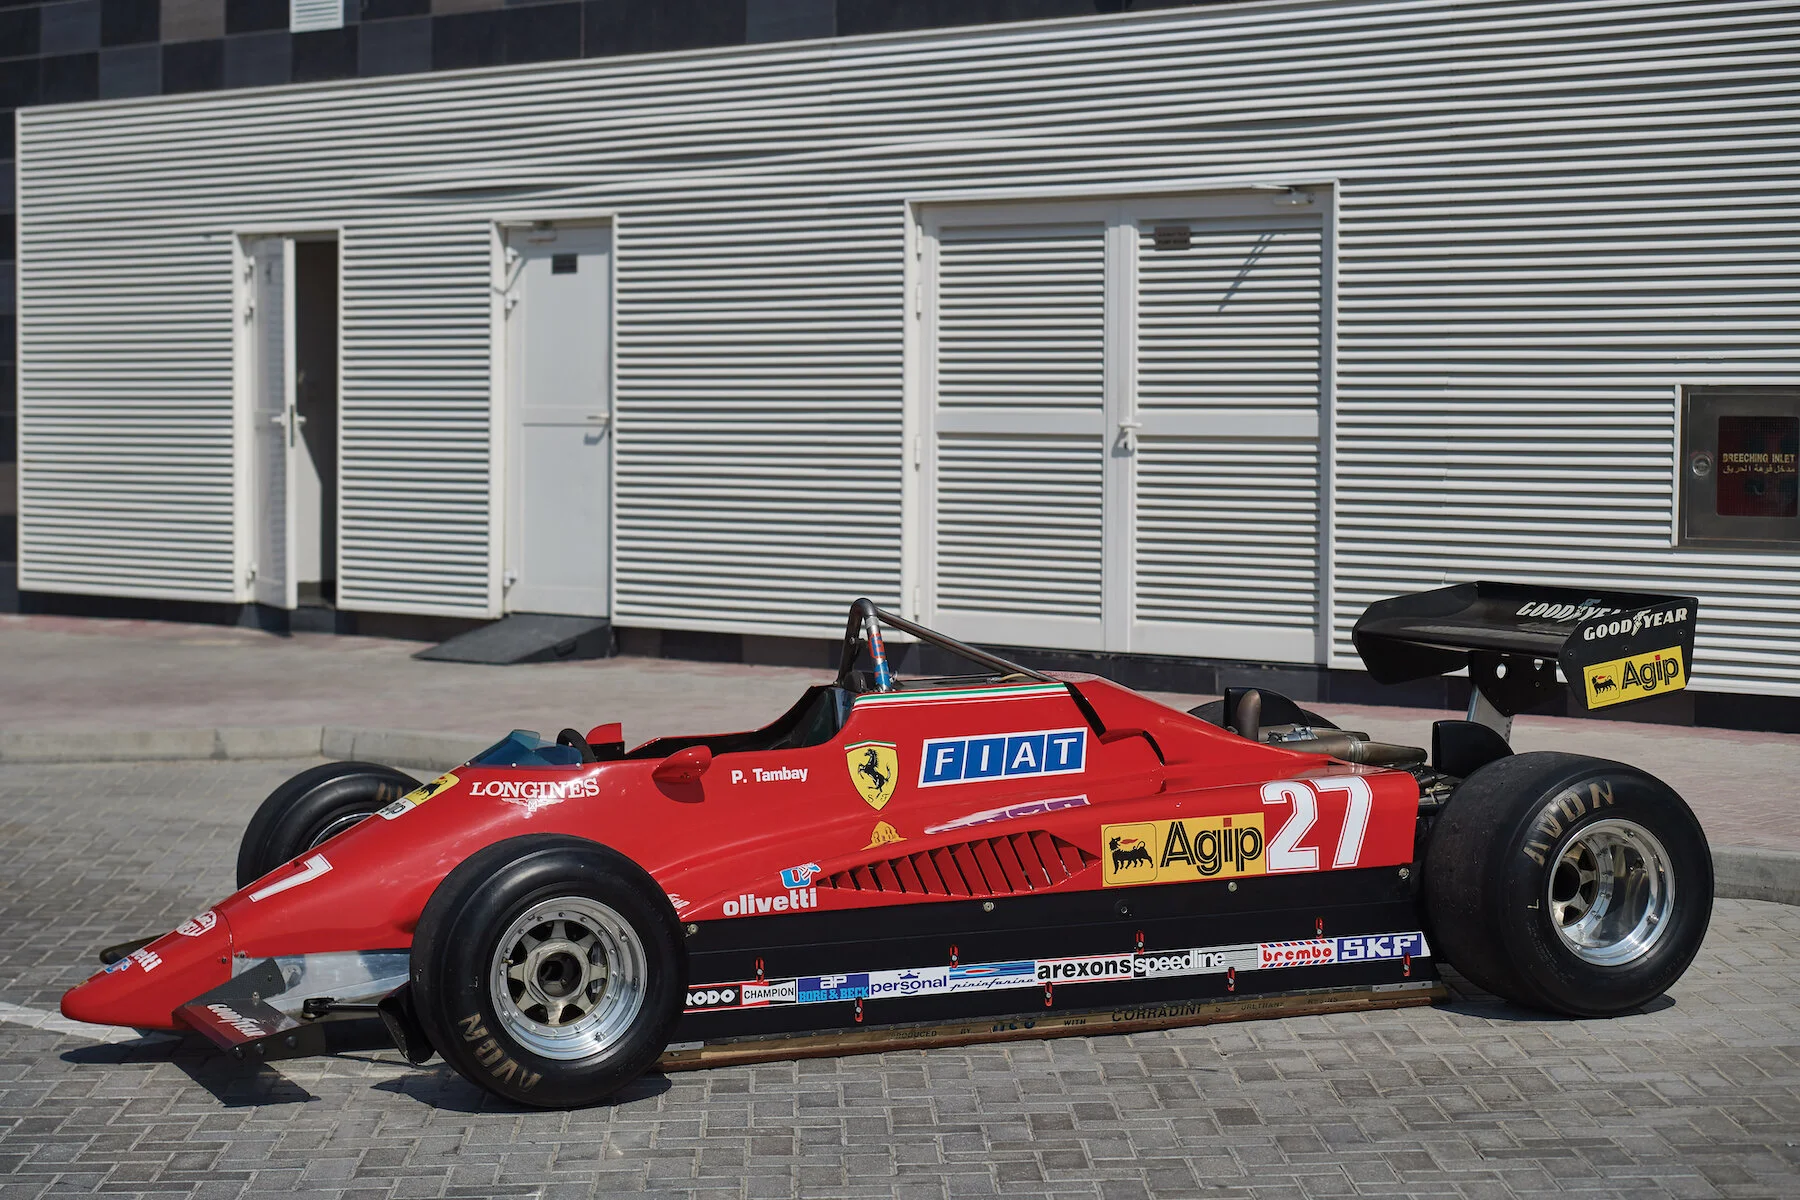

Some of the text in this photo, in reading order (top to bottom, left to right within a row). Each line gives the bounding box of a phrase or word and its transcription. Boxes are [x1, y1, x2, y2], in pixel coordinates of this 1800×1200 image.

[1723, 453, 1796, 463] BREECHING INLET
[1583, 608, 1688, 641] GOODYEAR
[1622, 654, 1680, 691] Agip
[934, 738, 1078, 776] FIAT
[731, 766, 809, 784] P. Tambay
[469, 778, 600, 799] LONGINES
[1260, 775, 1373, 874] 27
[1523, 779, 1616, 867] AVON
[1160, 818, 1263, 877] Agip
[723, 887, 818, 916] olivetti
[1263, 946, 1332, 962] brembo
[1341, 934, 1418, 960] SKF
[1037, 958, 1132, 980] arexons
[1134, 949, 1226, 973] speedline
[744, 987, 795, 1000] CHAMPION
[798, 988, 827, 1003] BORG
[841, 986, 869, 999] BECK
[871, 975, 947, 995] personal
[950, 977, 1035, 992] pininfarina
[1064, 1018, 1086, 1026] WITH
[1112, 1004, 1200, 1022] CORRADINI
